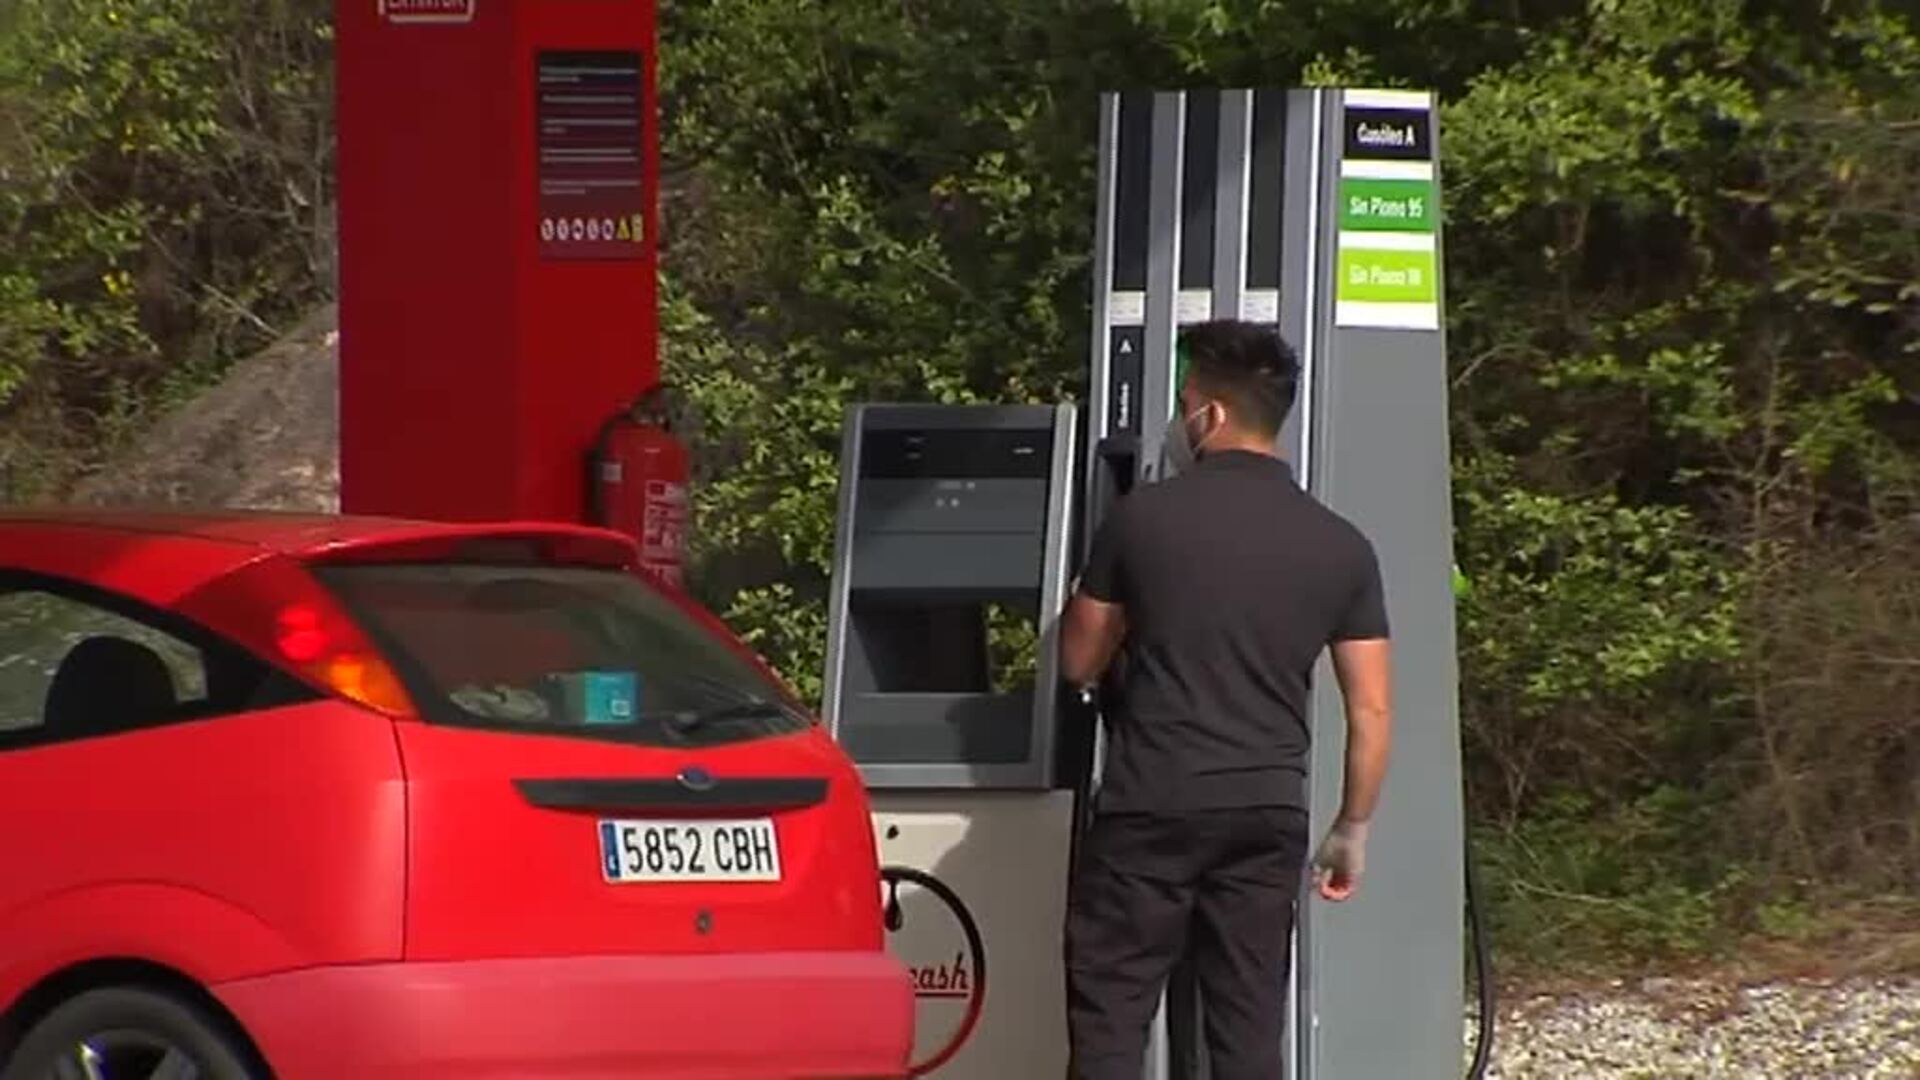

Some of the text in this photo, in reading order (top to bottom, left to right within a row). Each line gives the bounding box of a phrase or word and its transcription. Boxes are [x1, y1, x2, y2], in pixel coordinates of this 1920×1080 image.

[1405, 125, 1416, 146] A
[1350, 196, 1423, 218] Sin Plomo 95
[1350, 264, 1367, 285] Sin
[623, 826, 773, 873] 5852 CBH
